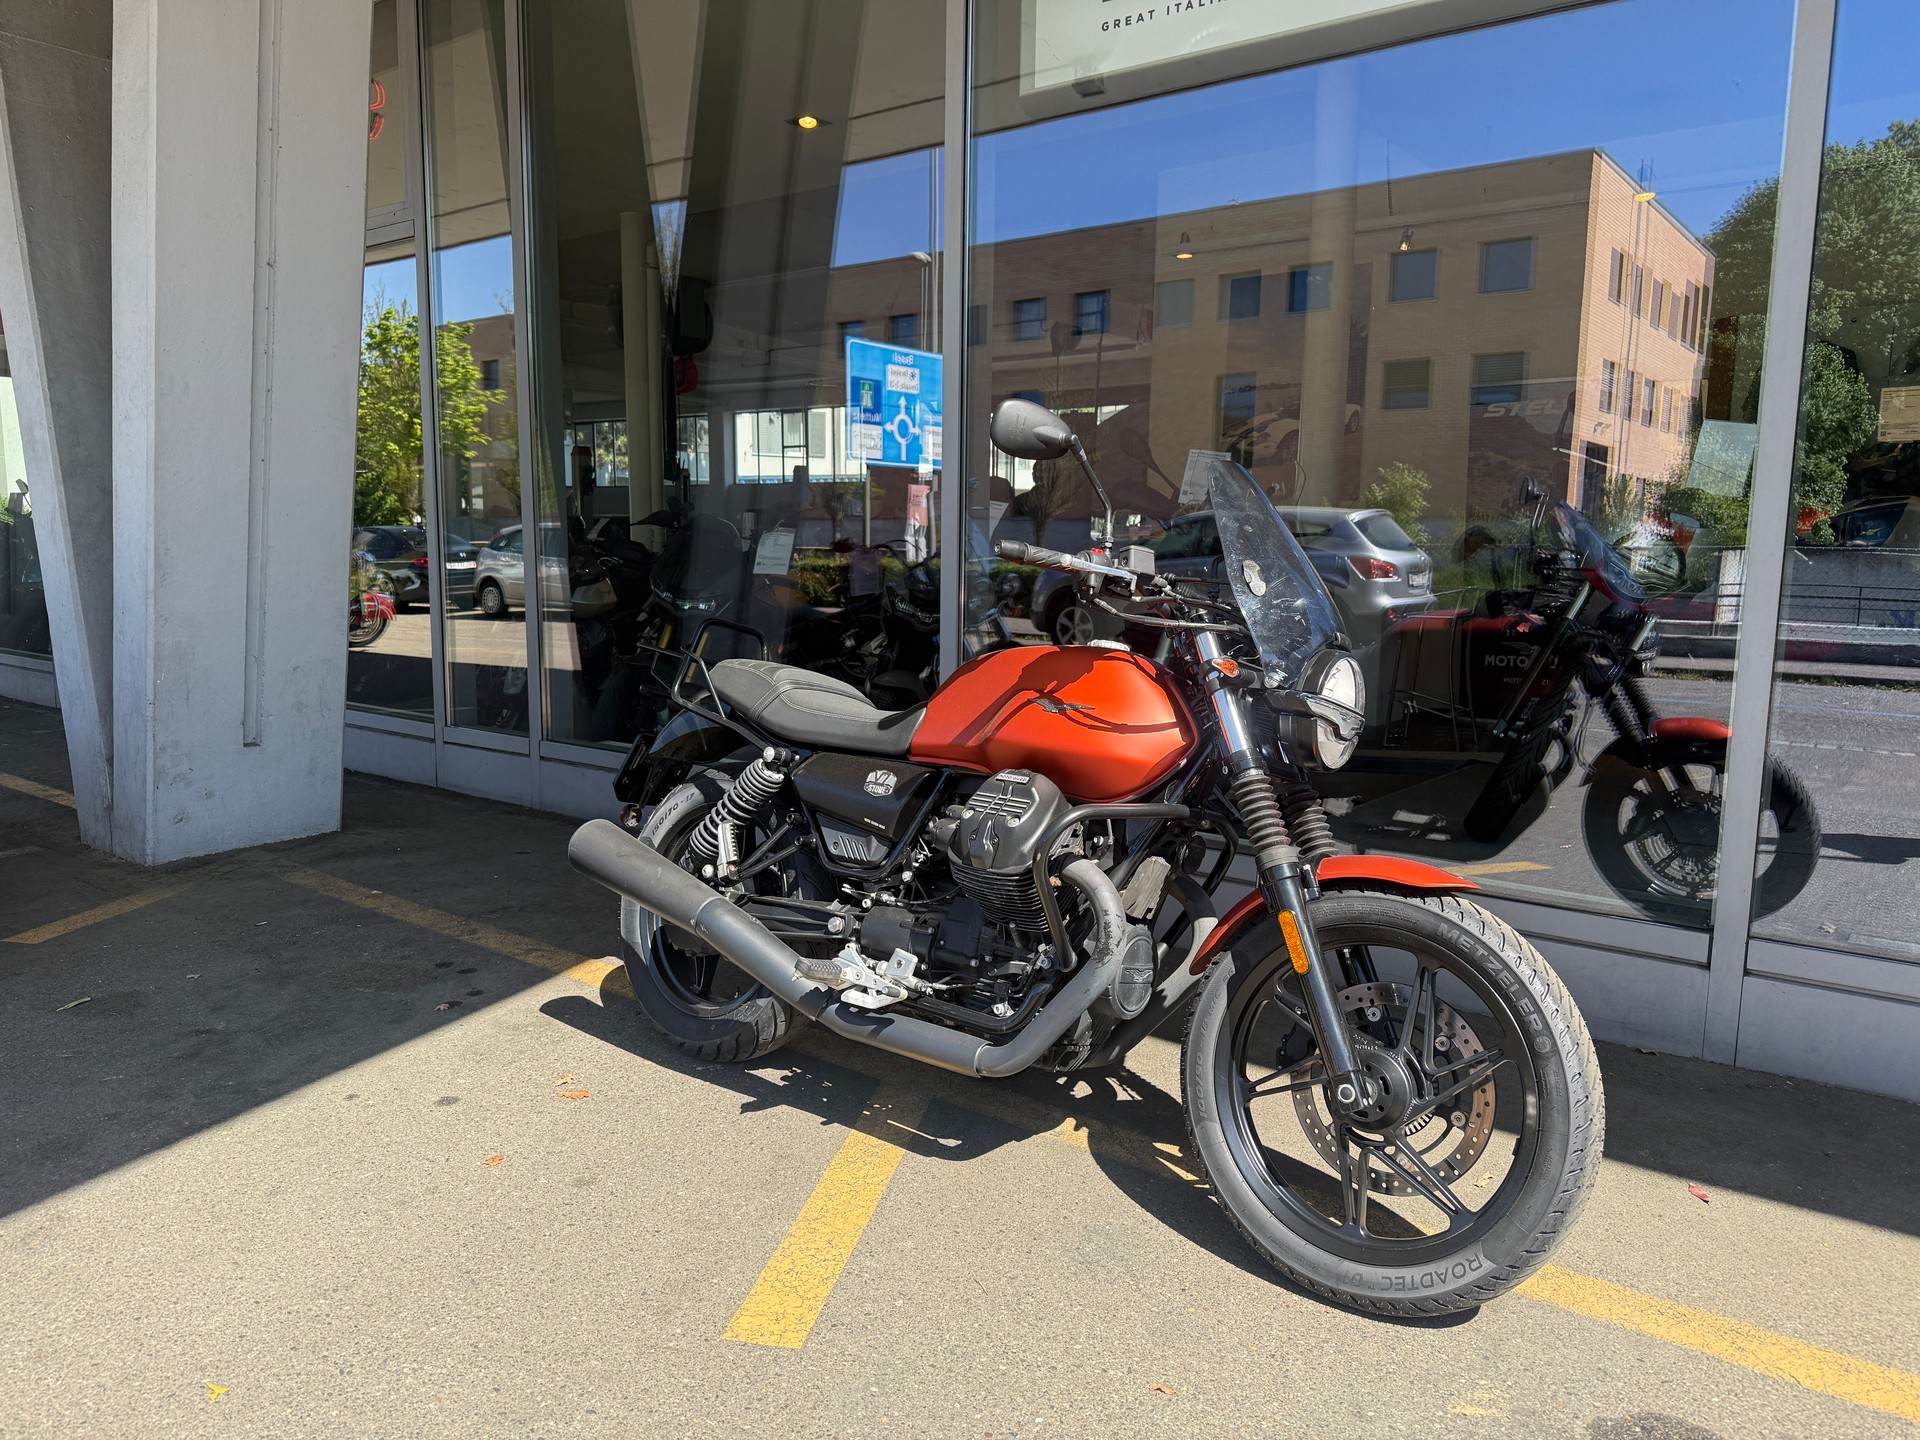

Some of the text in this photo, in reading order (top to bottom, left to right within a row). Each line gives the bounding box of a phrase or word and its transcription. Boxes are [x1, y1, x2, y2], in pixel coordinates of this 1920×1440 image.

[1101, 0, 1227, 32] GREAT ITAL
[1484, 654, 1529, 668] MOTO
[651, 802, 679, 836] 150/70
[1435, 922, 1544, 1037] METZELER
[1195, 1052, 1208, 1119] 100/90
[1380, 1252, 1484, 1292] ROADTEC
